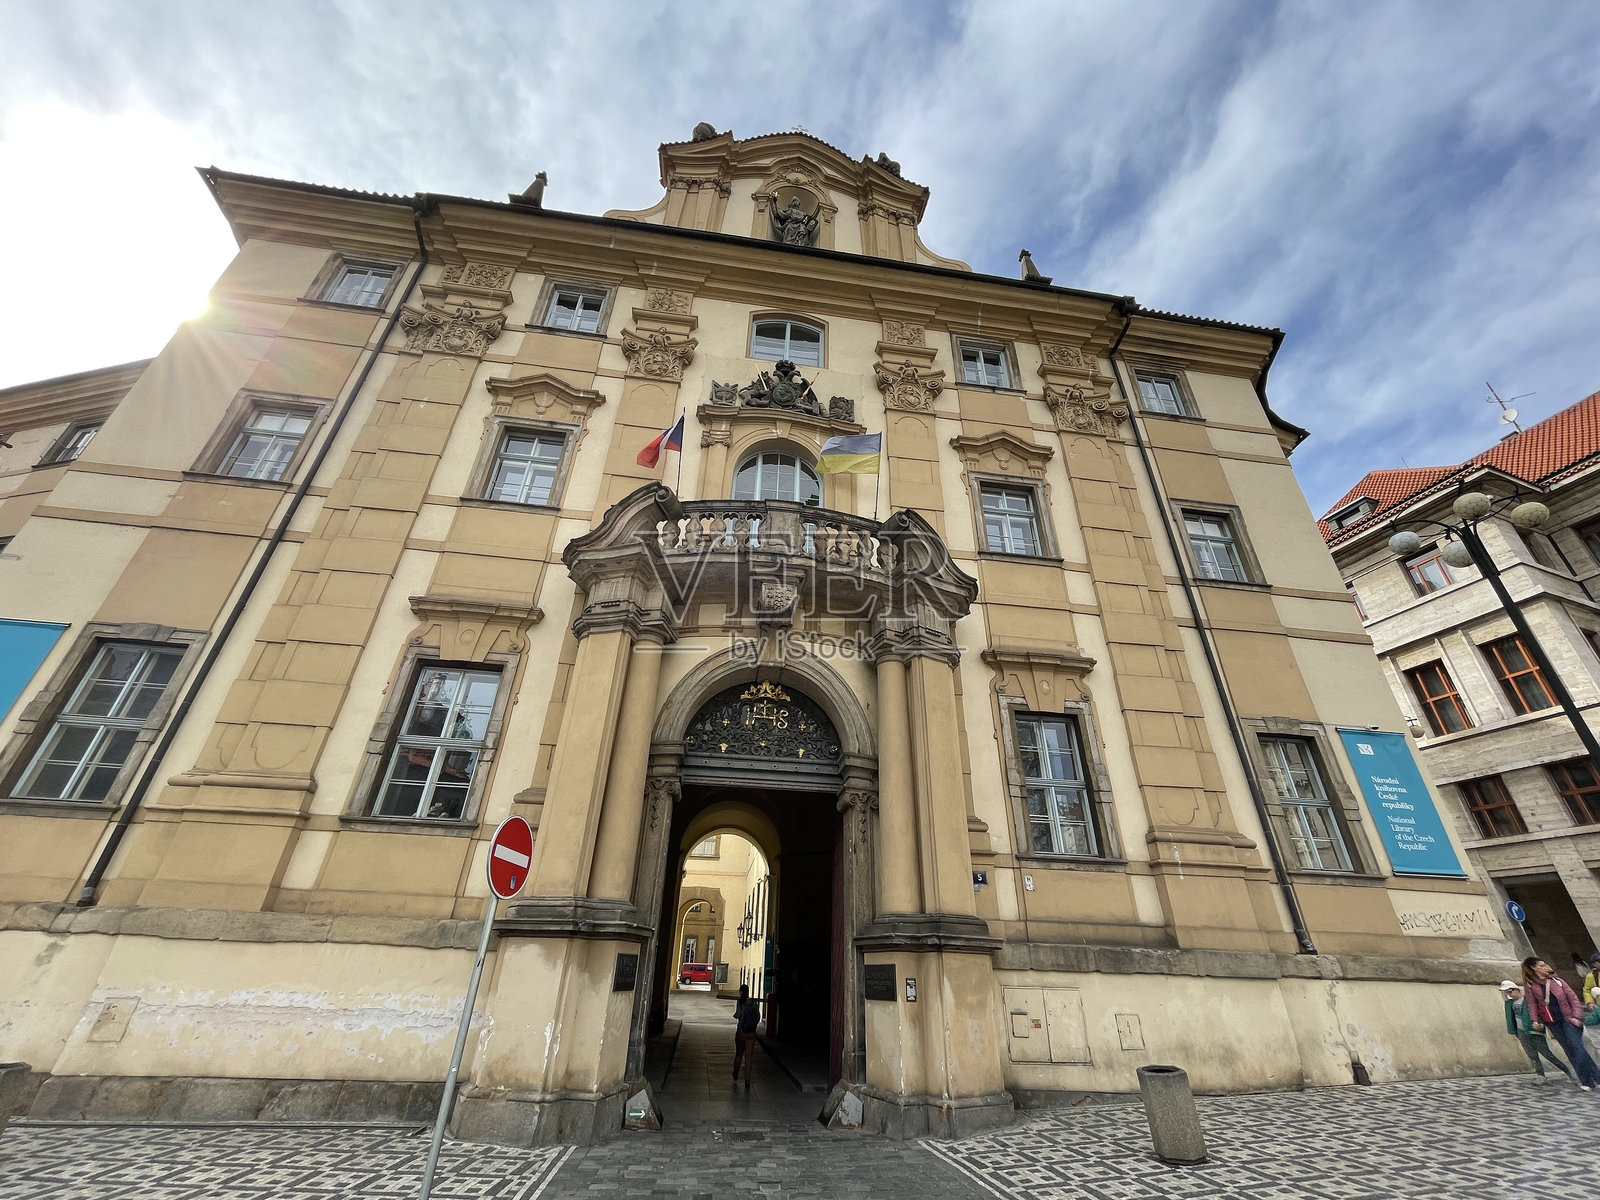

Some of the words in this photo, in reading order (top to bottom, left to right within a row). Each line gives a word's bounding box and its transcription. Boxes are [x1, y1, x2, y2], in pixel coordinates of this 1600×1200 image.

[1371, 776, 1399, 784] Národní
[1375, 784, 1407, 793] knihovna
[1382, 802, 1414, 811] republiky
[1387, 815, 1415, 824] National
[1391, 824, 1414, 834] Library
[1395, 833, 1402, 841] of
[1414, 834, 1434, 842] Czech
[1398, 842, 1427, 851] Republic
[977, 873, 983, 881] 5
